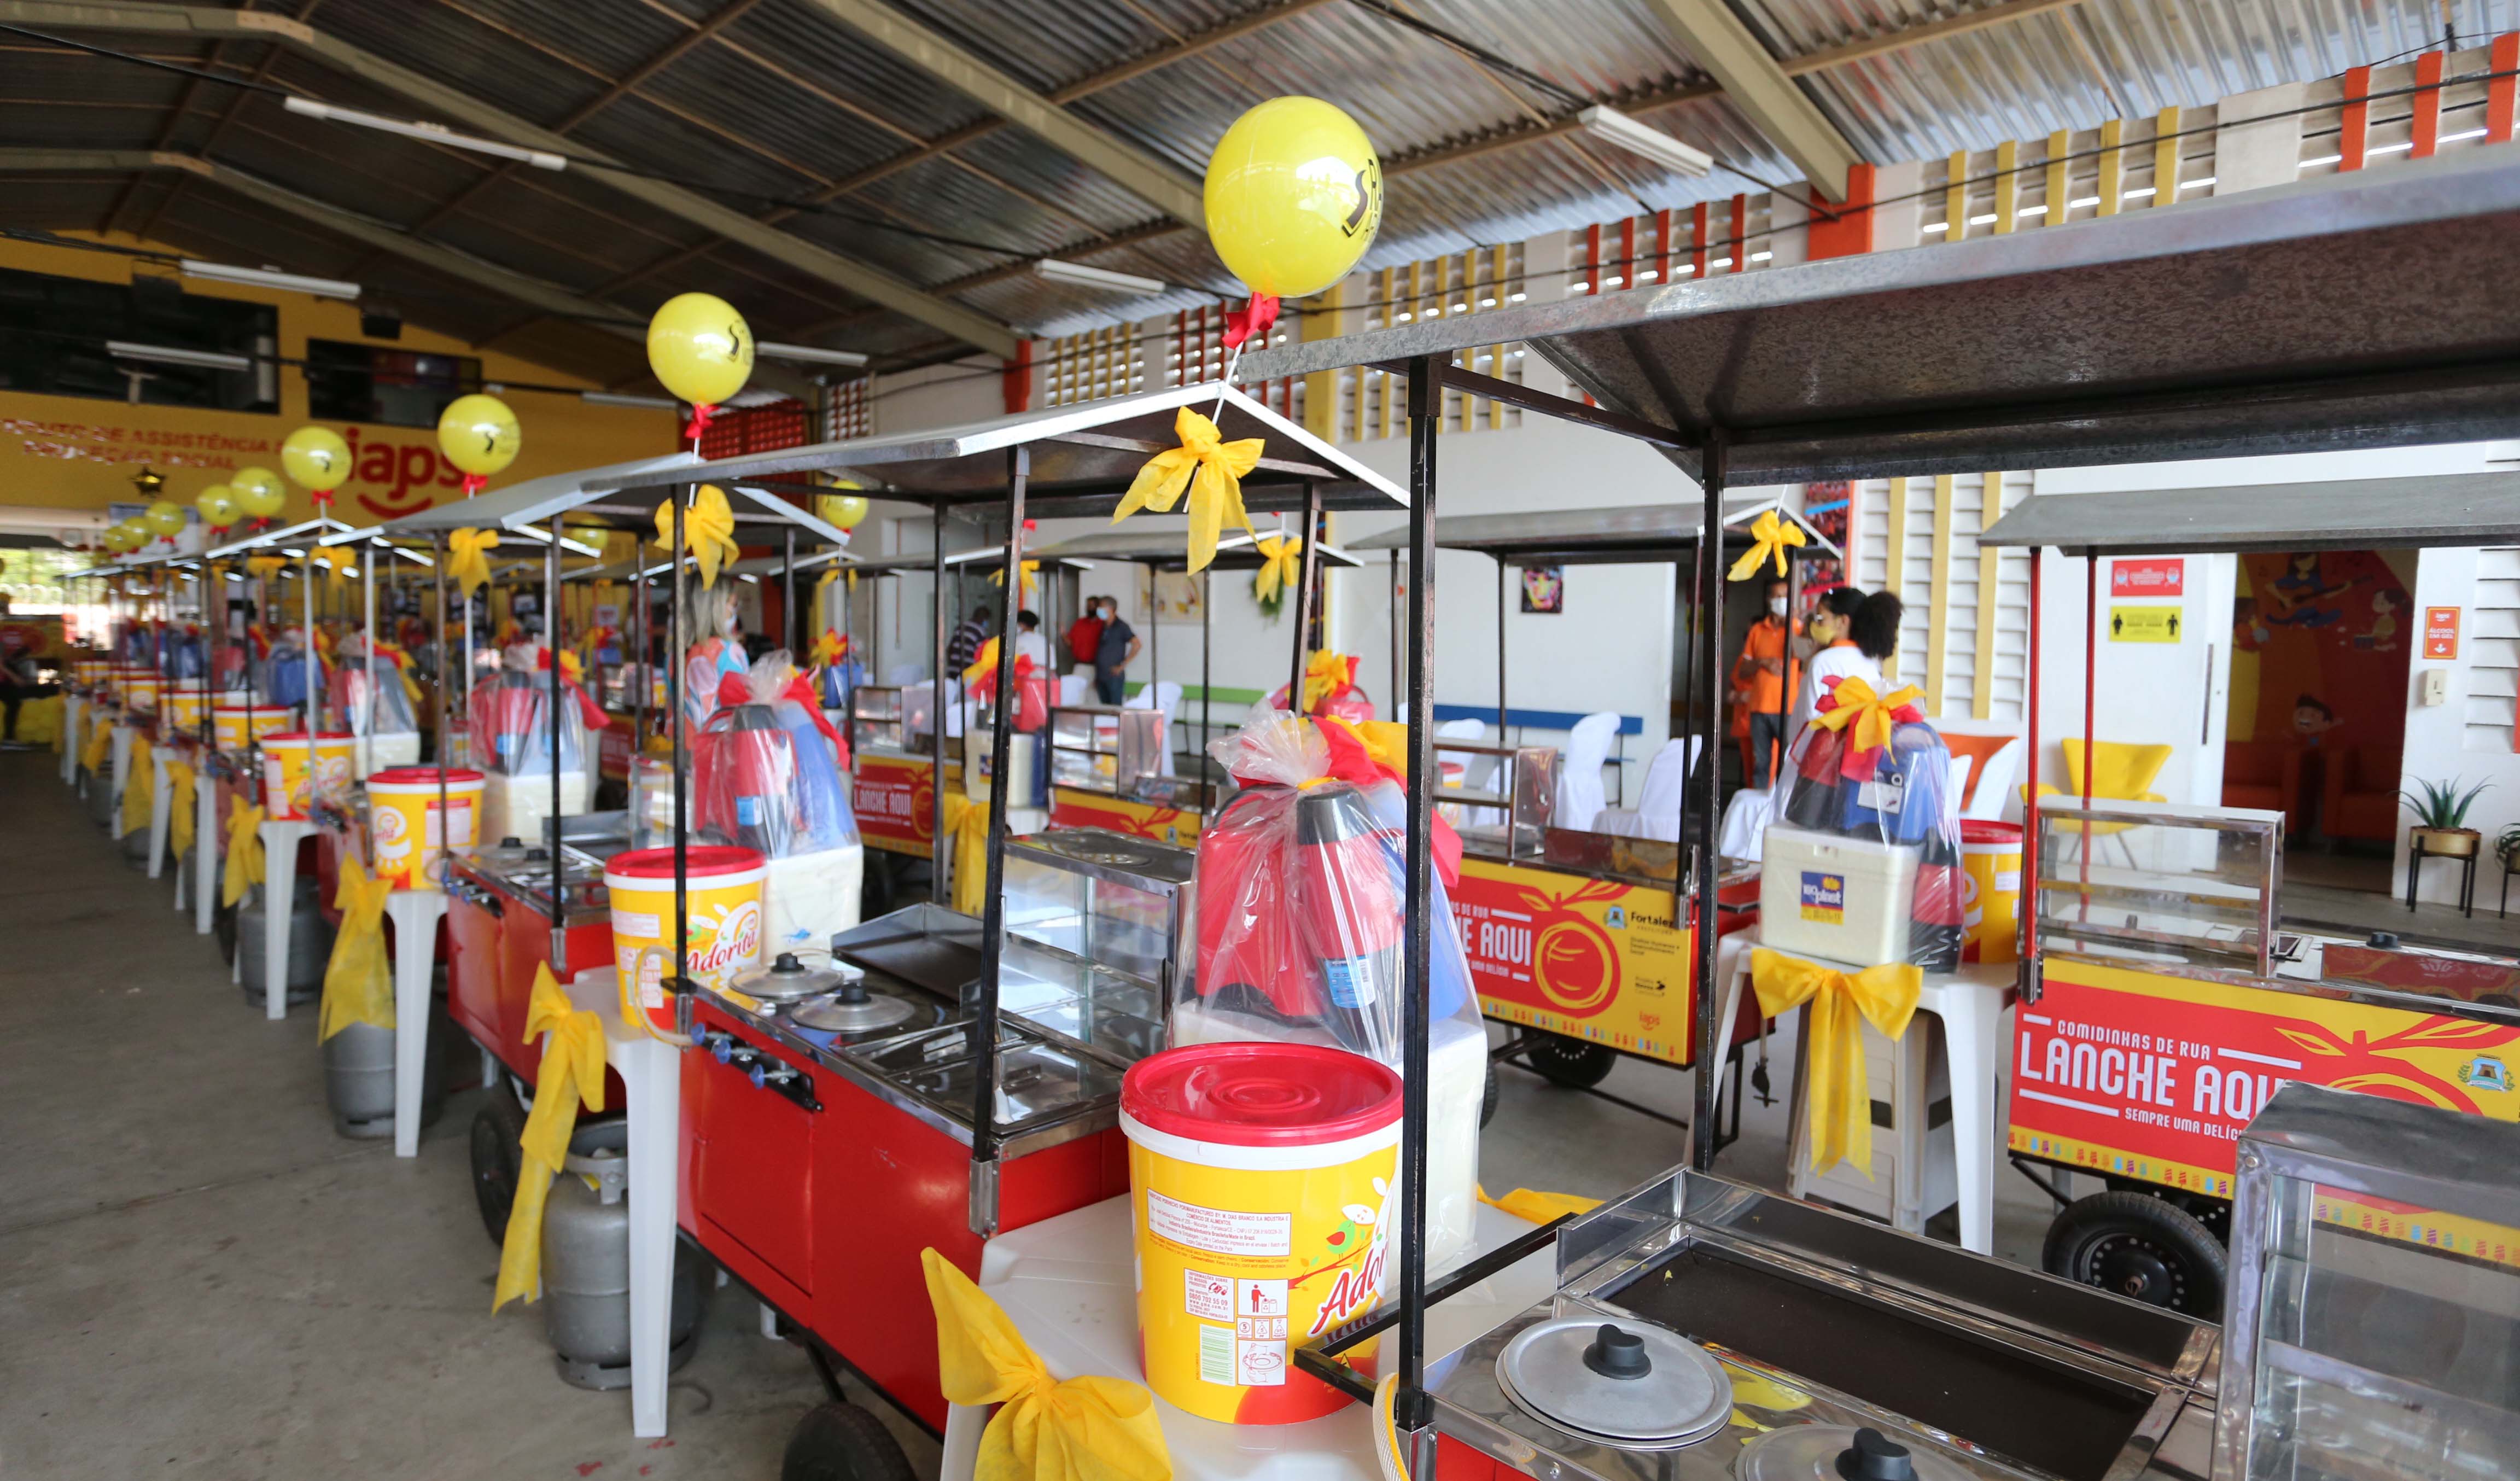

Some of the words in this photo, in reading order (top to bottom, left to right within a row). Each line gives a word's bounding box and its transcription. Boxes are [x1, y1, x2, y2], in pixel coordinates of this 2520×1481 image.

[133, 429, 269, 452] ASSISTÊNCIA
[161, 450, 237, 470] SOCIAL
[854, 786, 886, 813] LANCHE
[889, 792, 912, 816] AQUI
[1480, 921, 1532, 966] AQUI
[2057, 1019, 2151, 1050] COMIDINHAS
[2156, 1037, 2174, 1054] DE
[2179, 1041, 2211, 1060] RUA
[2020, 1031, 2177, 1107] LANCHE
[2125, 1107, 2169, 1127] SEMPRE
[2173, 1117, 2200, 1134] UMA
[1189, 1292, 1201, 1301] 0800
[1202, 1296, 1211, 1304] 702
